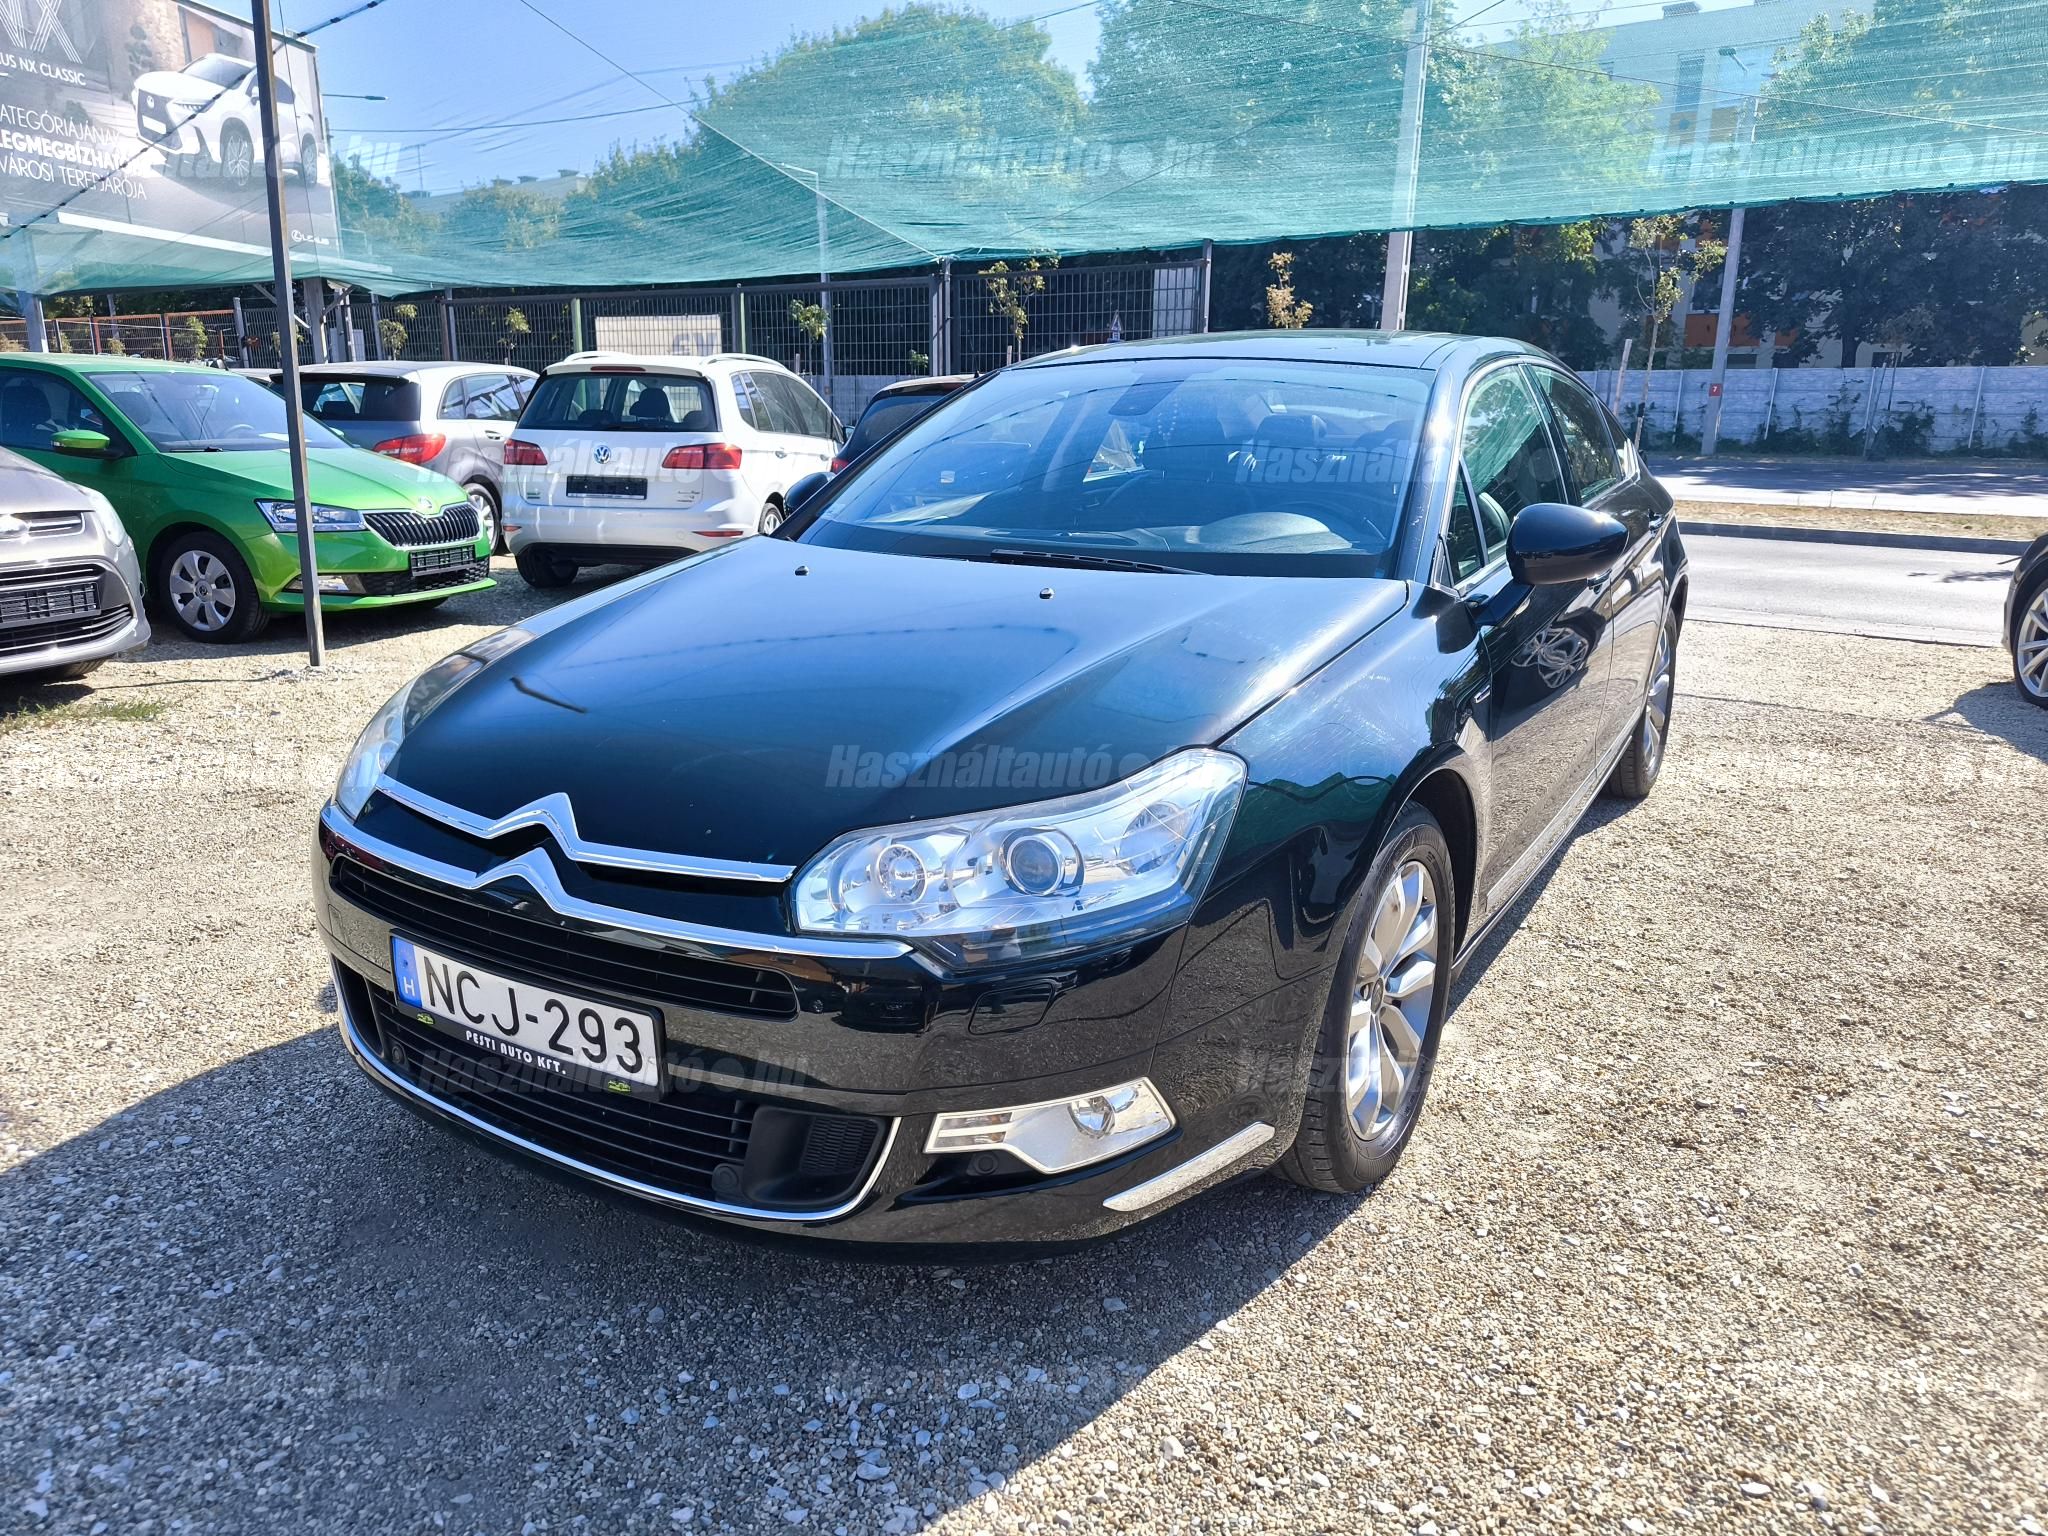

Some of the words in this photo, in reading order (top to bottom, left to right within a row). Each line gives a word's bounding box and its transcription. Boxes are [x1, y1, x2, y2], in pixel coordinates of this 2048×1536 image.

[0, 52, 17, 68] US
[20, 57, 38, 73] NX
[40, 62, 87, 86] CLASSIC
[0, 103, 120, 144] ATEGÓRIÁJÁNAK
[0, 152, 54, 182] VÁROSI
[403, 975, 416, 997] H
[423, 955, 643, 1074] NCJ-293
[466, 1030, 496, 1051] PESTI
[500, 1042, 533, 1063] AUTO
